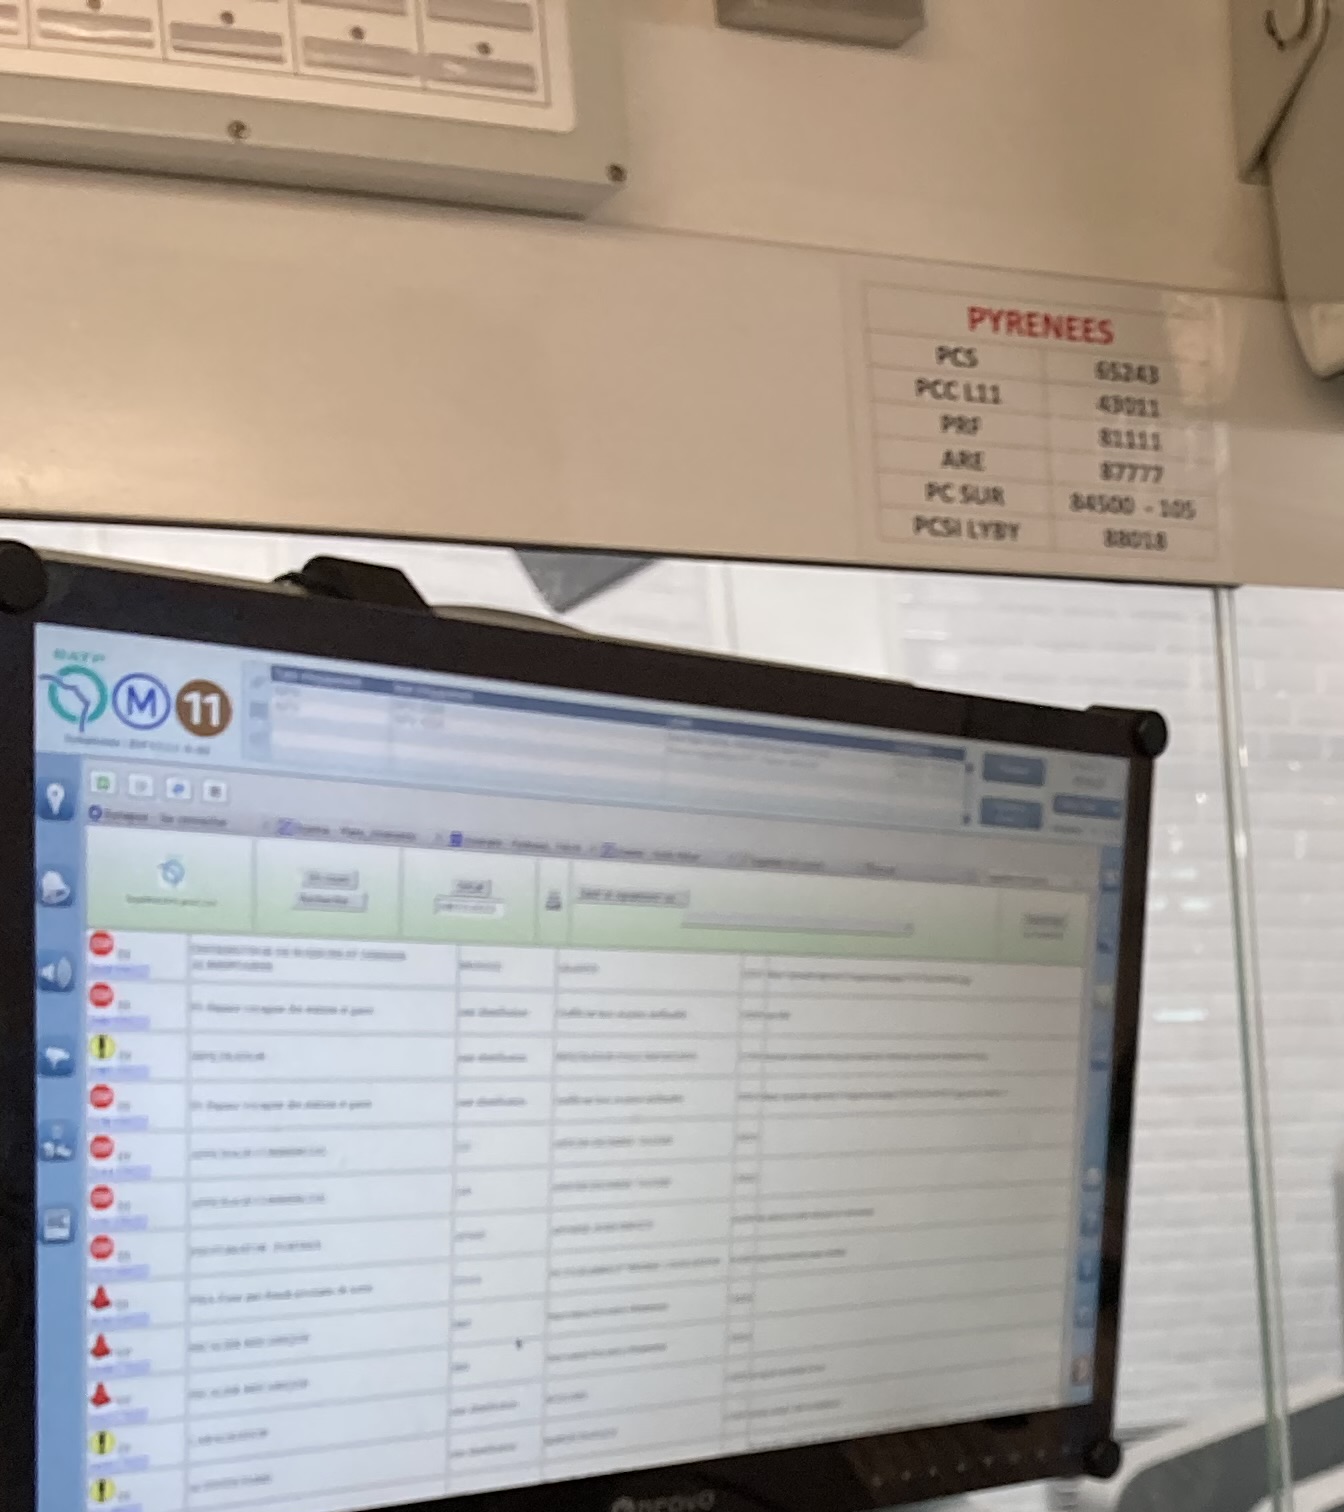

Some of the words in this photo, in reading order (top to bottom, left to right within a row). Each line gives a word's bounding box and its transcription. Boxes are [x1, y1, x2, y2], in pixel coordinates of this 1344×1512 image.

[967, 305, 1115, 345] PYRENEES
[935, 345, 979, 368] PCS
[914, 377, 959, 401] PCC
[963, 383, 1002, 405] L11
[924, 481, 954, 504] PC
[127, 684, 157, 718] M
[184, 690, 221, 728] 11
